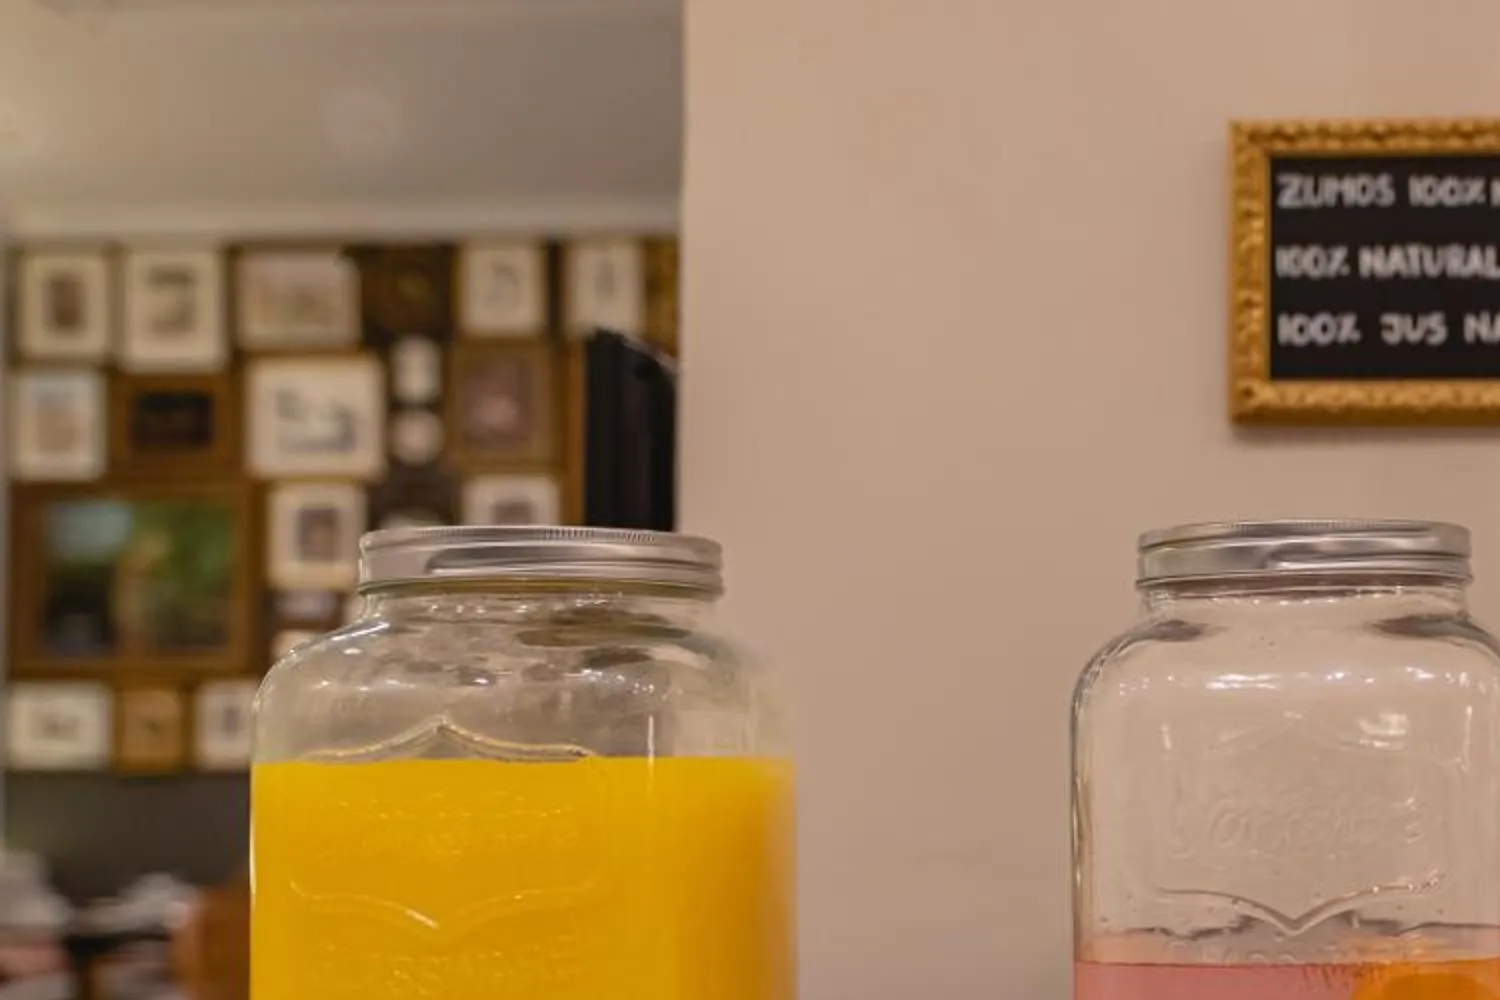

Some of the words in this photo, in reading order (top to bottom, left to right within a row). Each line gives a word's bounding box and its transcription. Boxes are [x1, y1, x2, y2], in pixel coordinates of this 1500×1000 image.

[1276, 172, 1397, 210] ZUMOS
[1407, 174, 1486, 208] 100%
[1275, 244, 1351, 279] 100%
[1276, 311, 1362, 347] 100%
[1379, 311, 1448, 346] JUS
